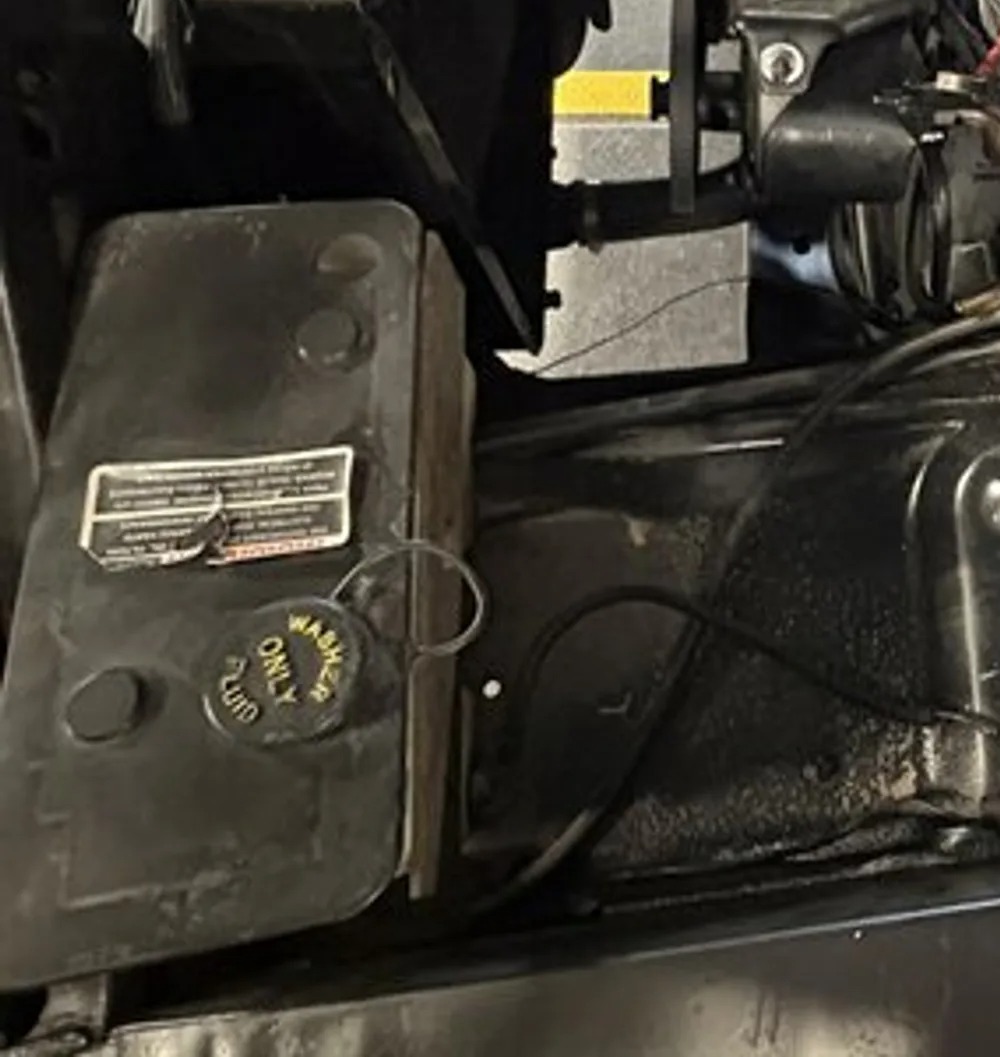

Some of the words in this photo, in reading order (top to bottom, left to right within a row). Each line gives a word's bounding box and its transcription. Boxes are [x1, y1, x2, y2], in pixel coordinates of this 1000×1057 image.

[221, 656, 259, 723] FLUID
[257, 636, 297, 704] ONLY
[288, 613, 343, 703] WASHER
